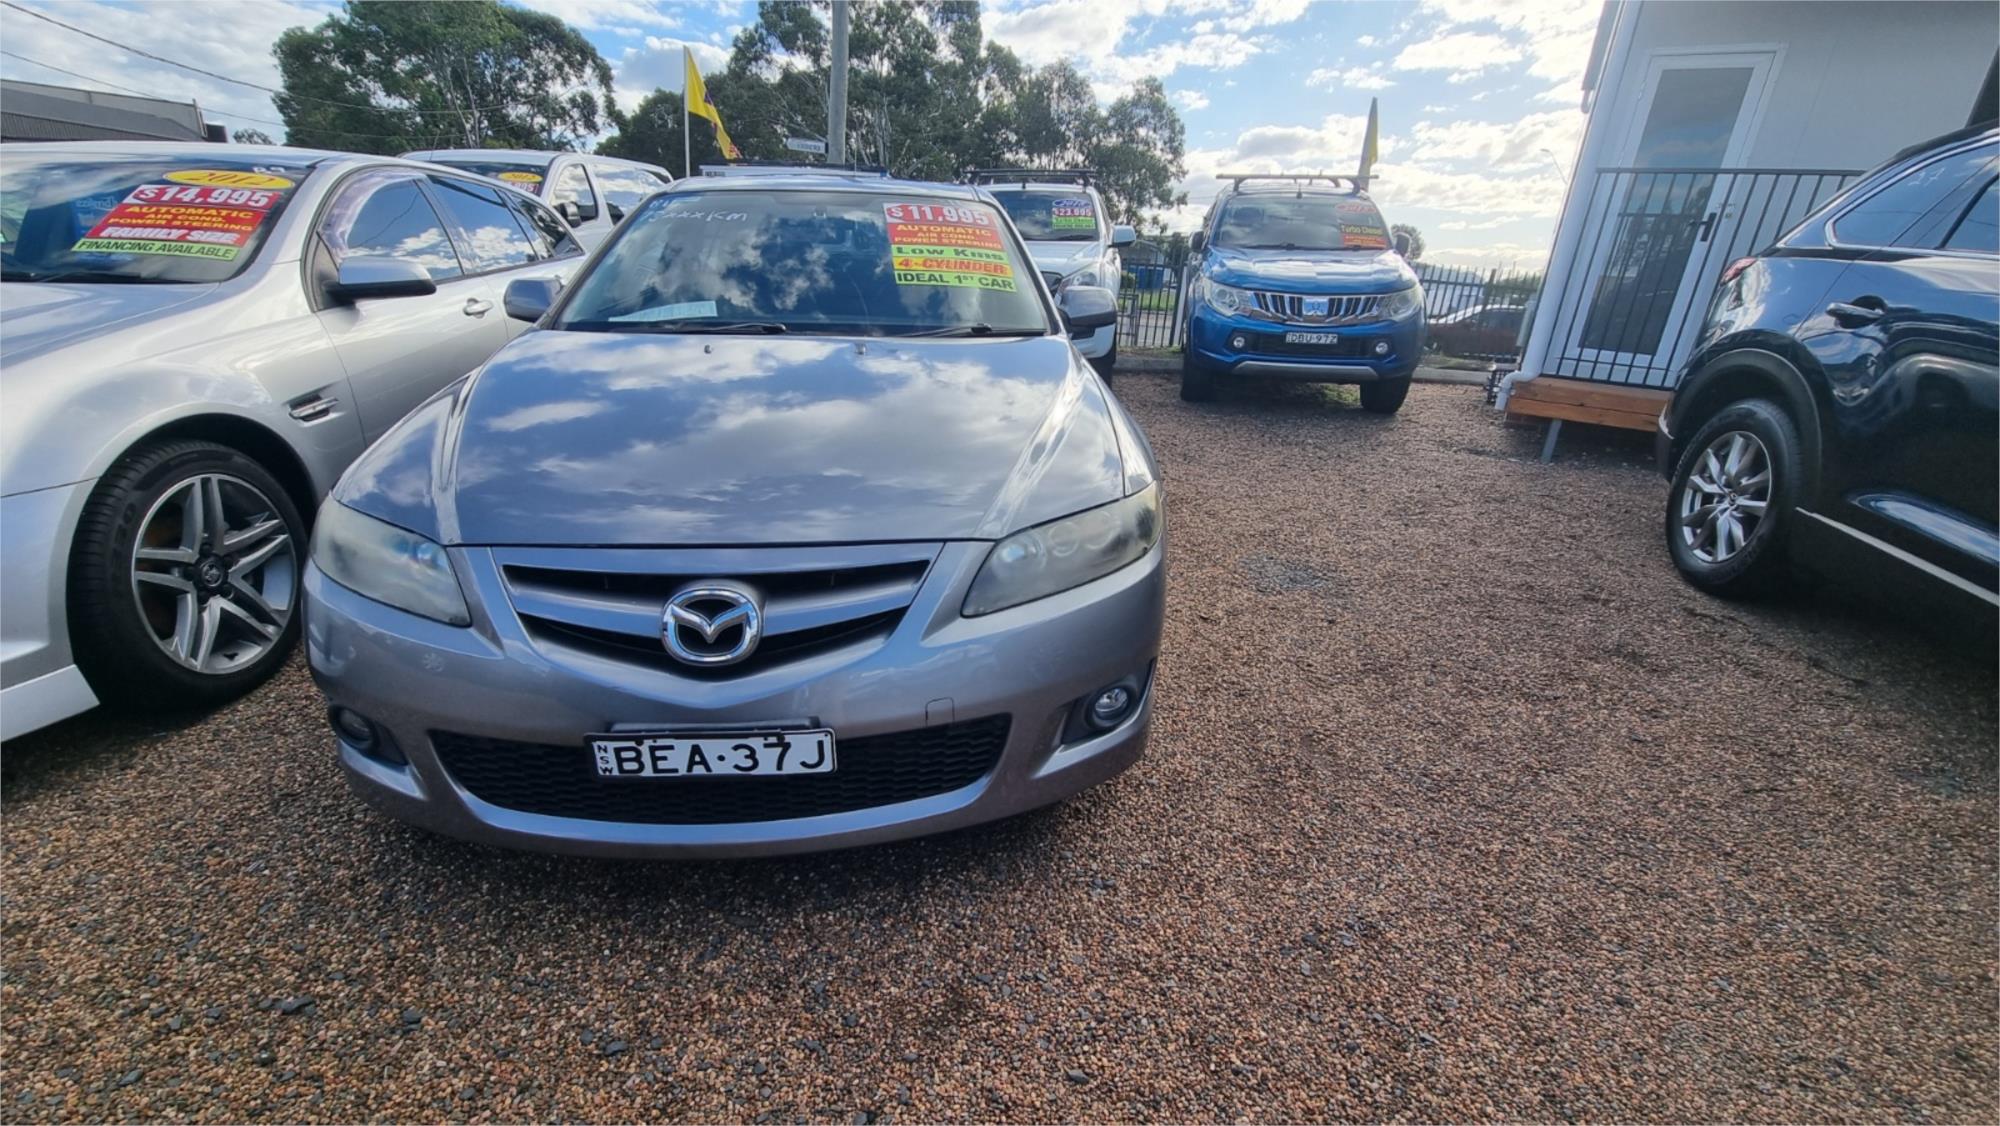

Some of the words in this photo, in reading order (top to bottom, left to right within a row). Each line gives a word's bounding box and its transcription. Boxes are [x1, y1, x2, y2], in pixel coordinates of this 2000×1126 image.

[139, 186, 272, 207] $14,995
[124, 205, 255, 219] AUTOMATIC
[144, 213, 174, 221] AIR
[107, 217, 168, 226] POWER
[171, 219, 254, 231] STEERING
[896, 224, 992, 237] AUTOMATIC
[99, 226, 185, 239] FAMILY
[187, 230, 241, 244] SIZE
[77, 239, 156, 252] FINANCING
[159, 242, 234, 259] AVAILABLE
[894, 236, 938, 244] POWER
[940, 238, 1002, 249] STEERING
[896, 272, 950, 284] IDEAL
[978, 276, 1014, 290] CAR
